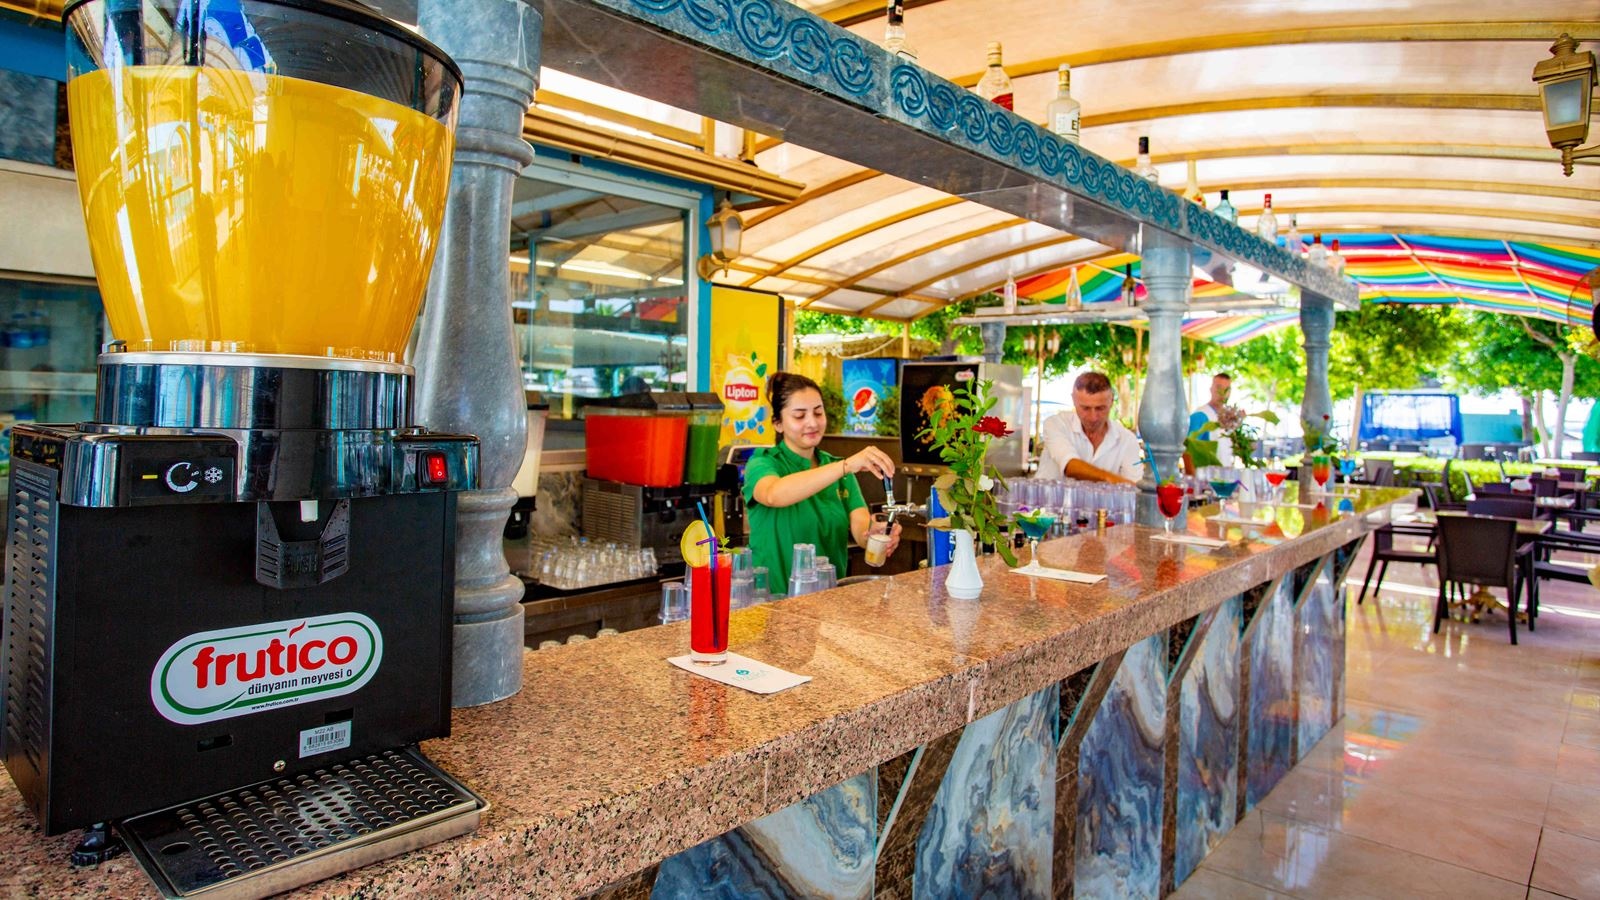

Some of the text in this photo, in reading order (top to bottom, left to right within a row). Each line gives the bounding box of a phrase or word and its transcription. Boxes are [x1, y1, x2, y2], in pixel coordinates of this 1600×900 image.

[726, 386, 757, 400] Lipton
[248, 668, 353, 696] dünyanın meyvesi o
